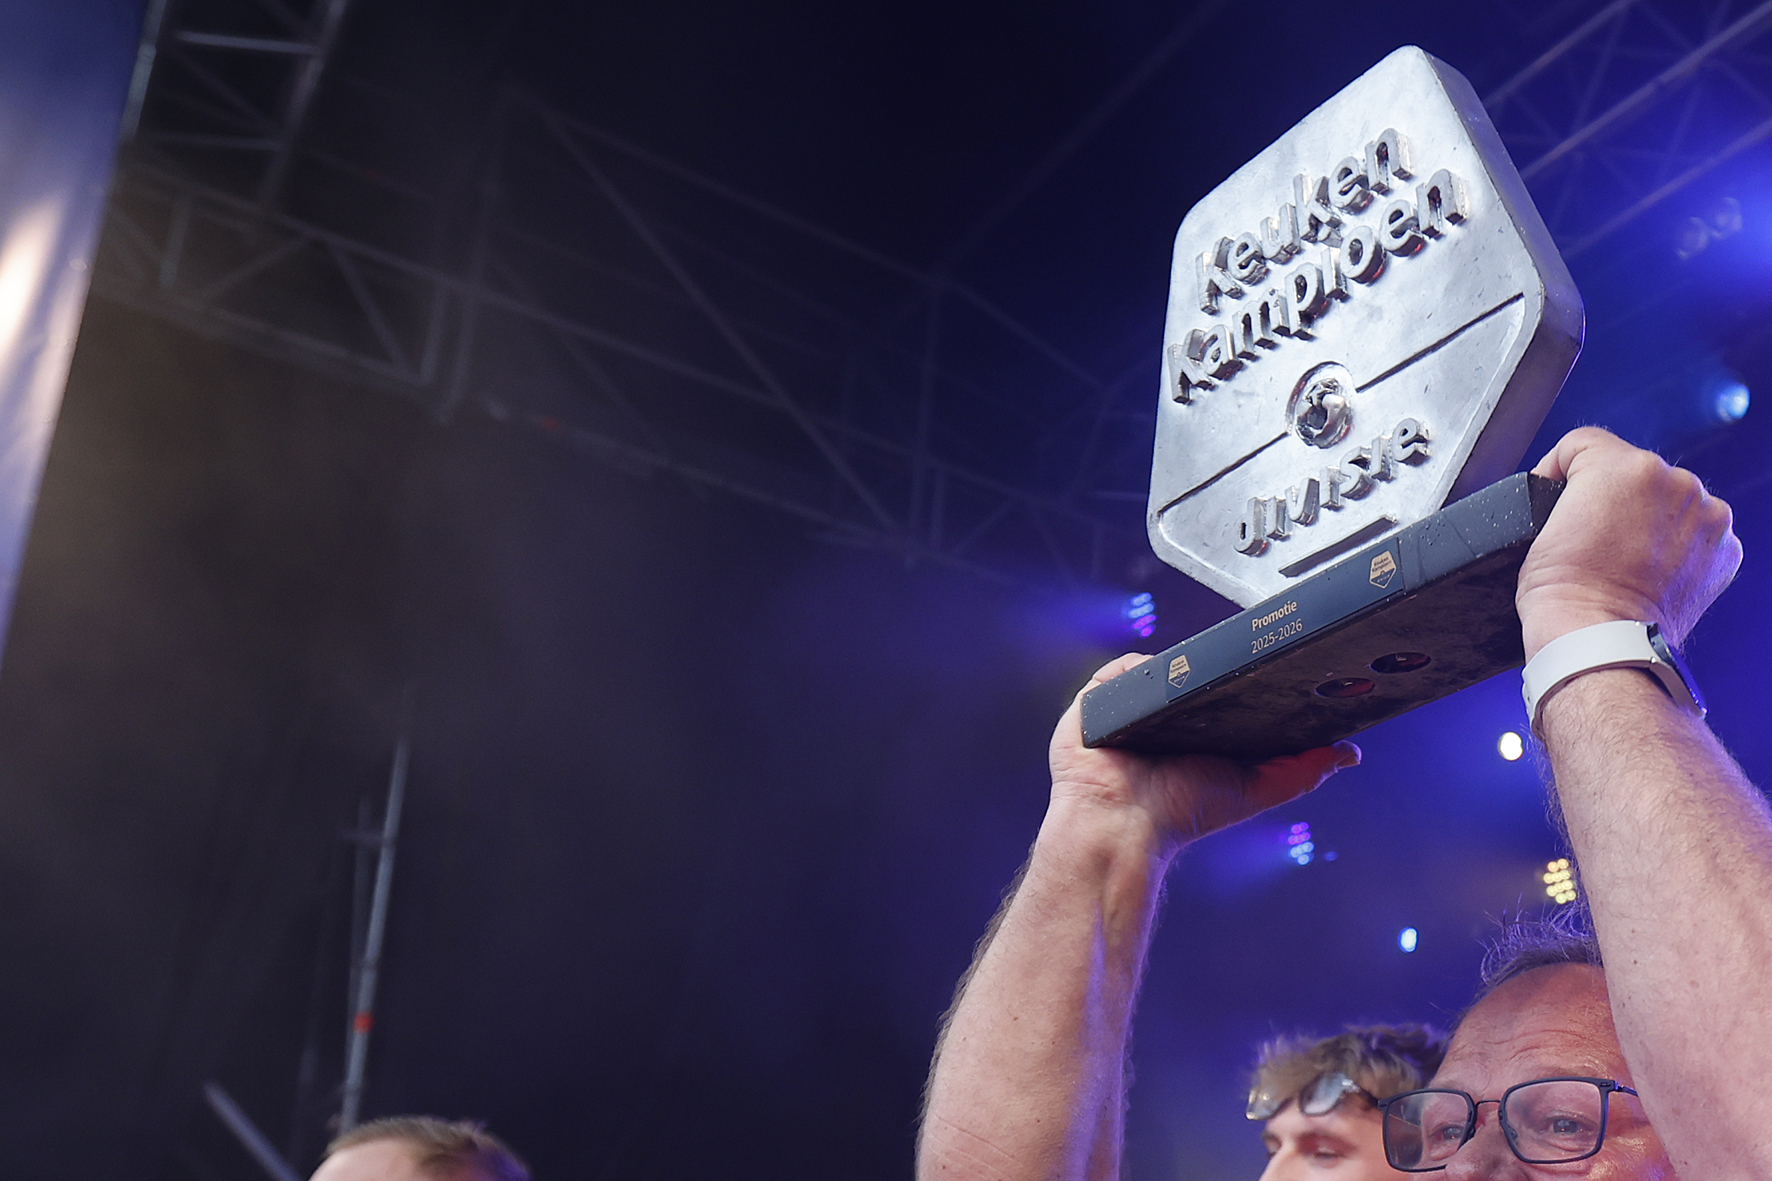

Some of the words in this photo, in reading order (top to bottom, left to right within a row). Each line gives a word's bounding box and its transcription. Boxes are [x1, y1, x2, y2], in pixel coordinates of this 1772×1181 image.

[1194, 128, 1414, 316] Keuken
[1233, 417, 1430, 557] divisie
[1250, 618, 1303, 654] 2025-2026
[1251, 600, 1298, 631] Promotie
